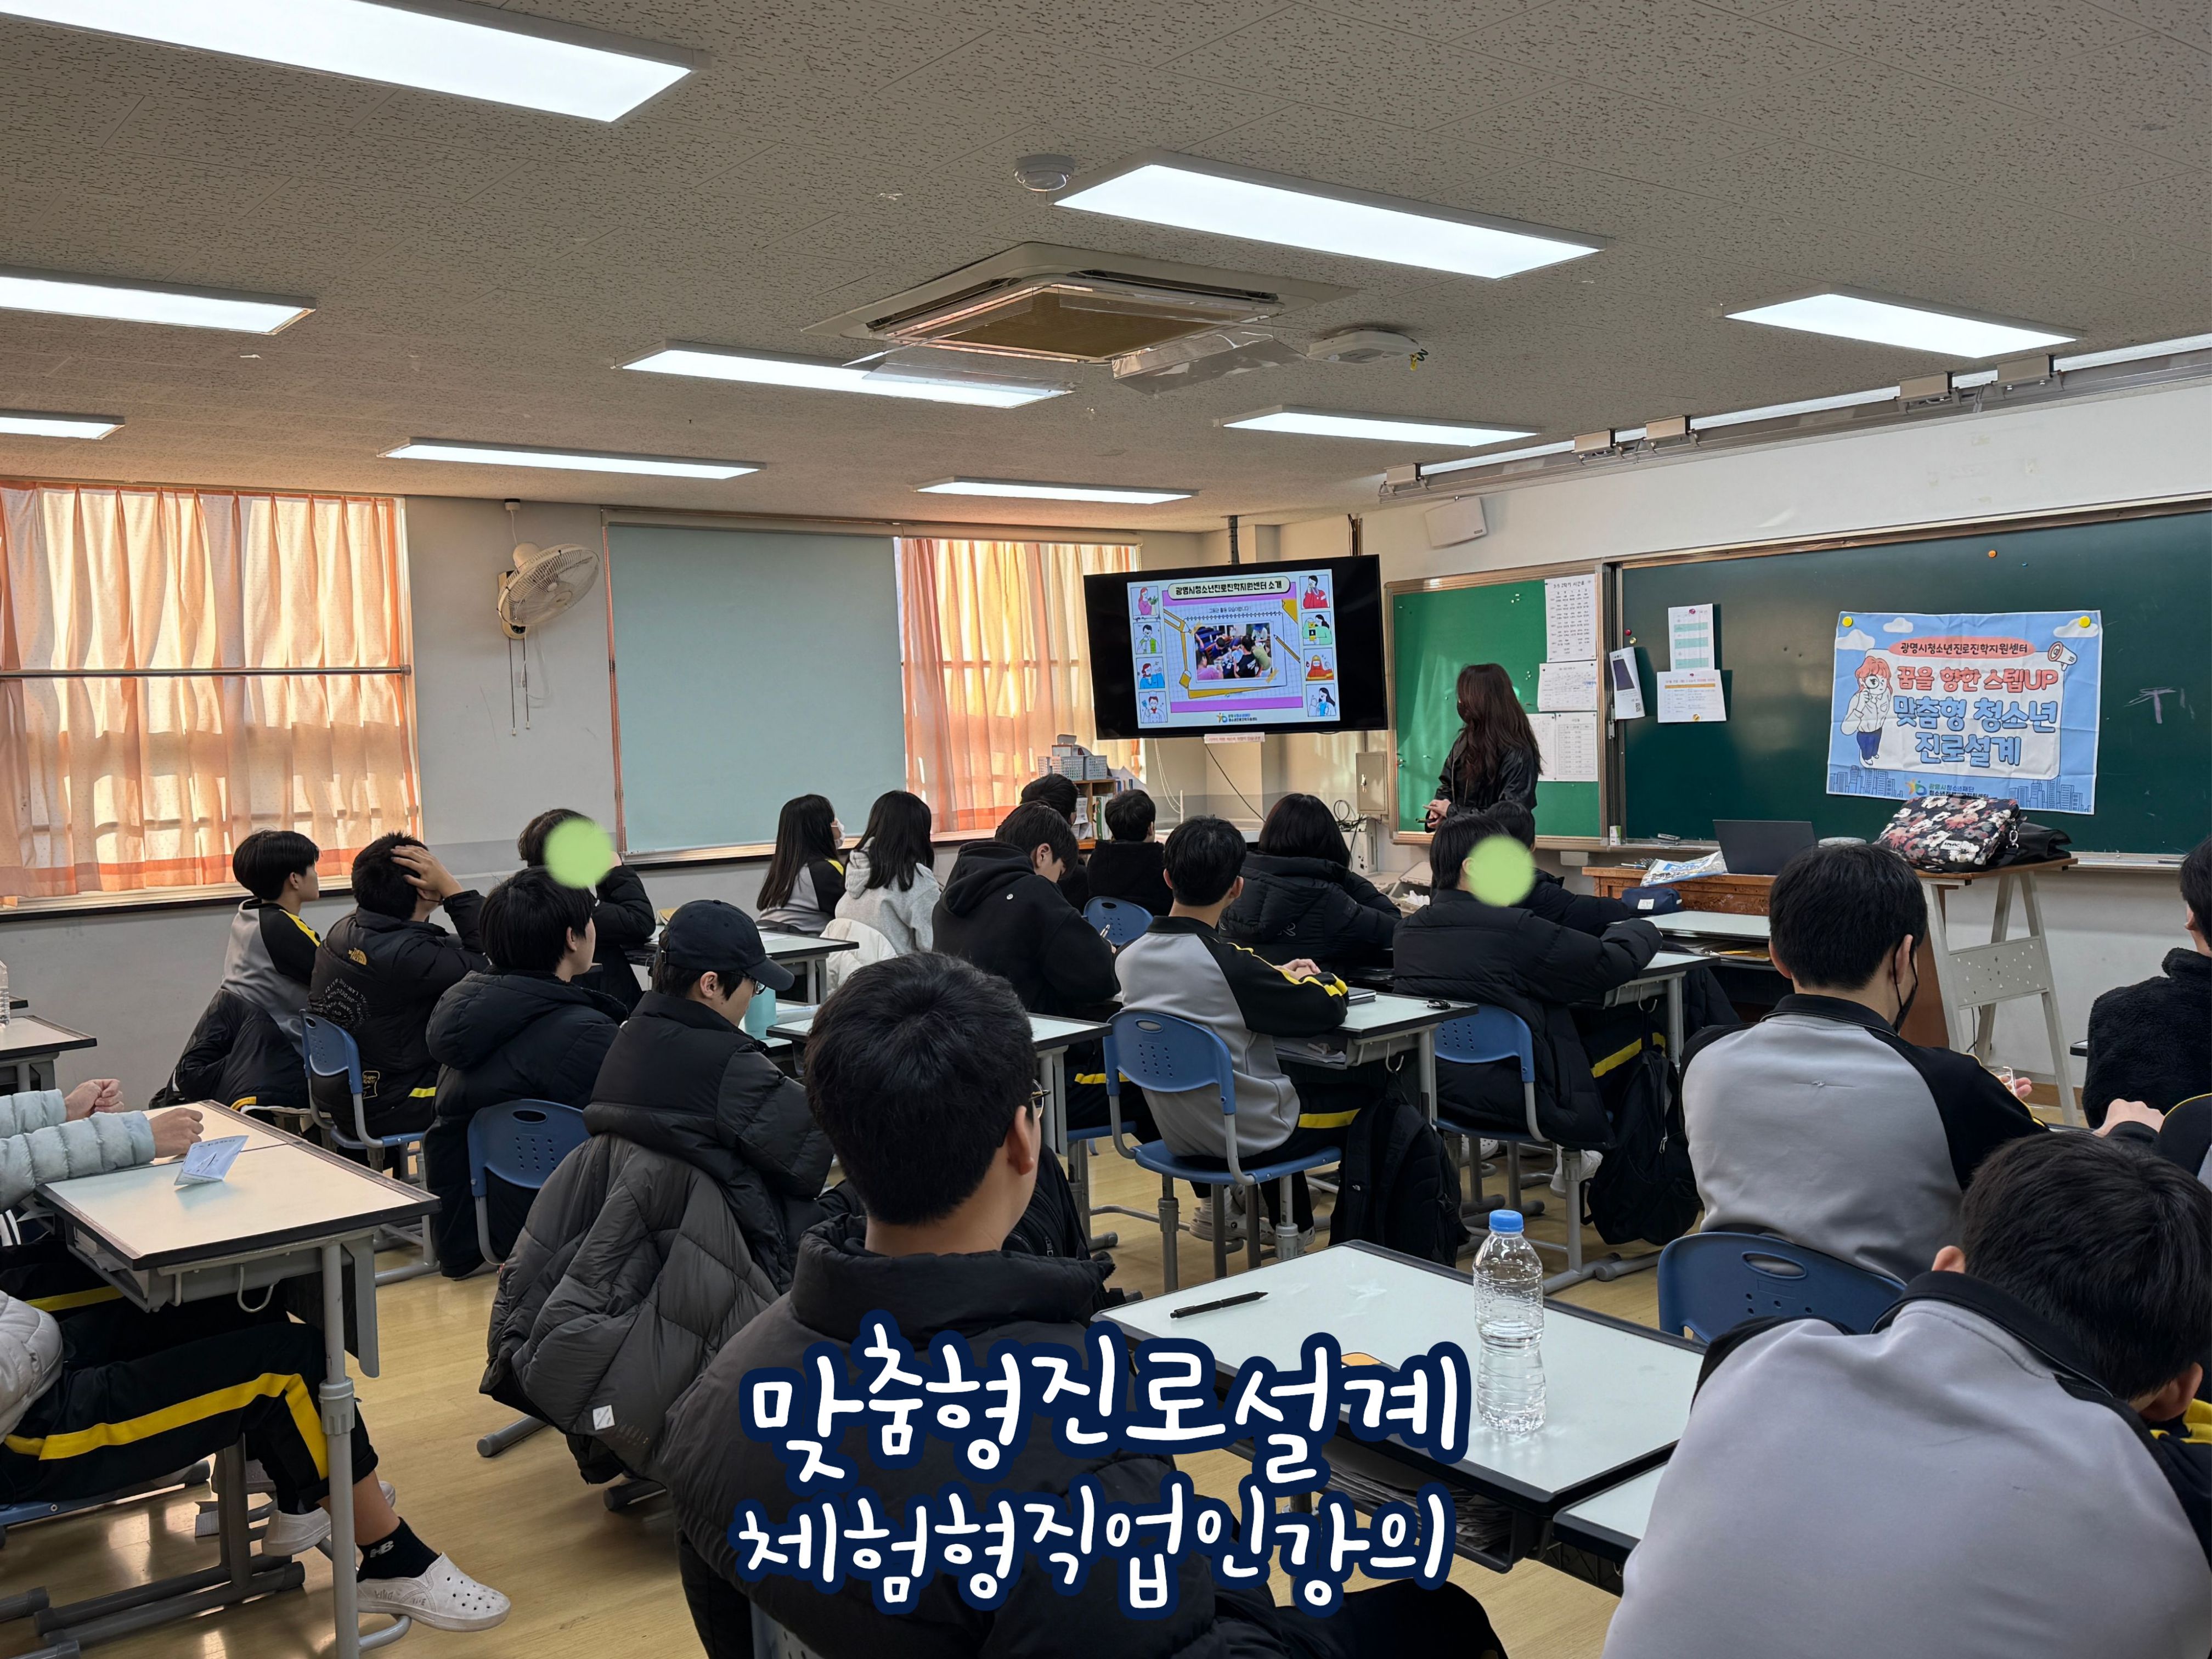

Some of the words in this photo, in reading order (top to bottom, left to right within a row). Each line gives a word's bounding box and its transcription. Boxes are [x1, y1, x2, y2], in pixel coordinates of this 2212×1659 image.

[1176, 581, 1267, 595] 광명시청소년진로진학지원센터
[1268, 580, 1282, 590] 소개
[1900, 642, 2028, 655] 광명시청소년진로진학지원센터
[1897, 665, 1935, 691] 꿈을
[1939, 667, 1980, 692] 향한
[1983, 668, 2058, 693] 스텝UP
[1893, 695, 1967, 731] 맞춤형
[1974, 697, 2058, 733] 청소년
[1915, 732, 2022, 768] 진로설계
[1929, 783, 1974, 793] 광명시청소년재단
